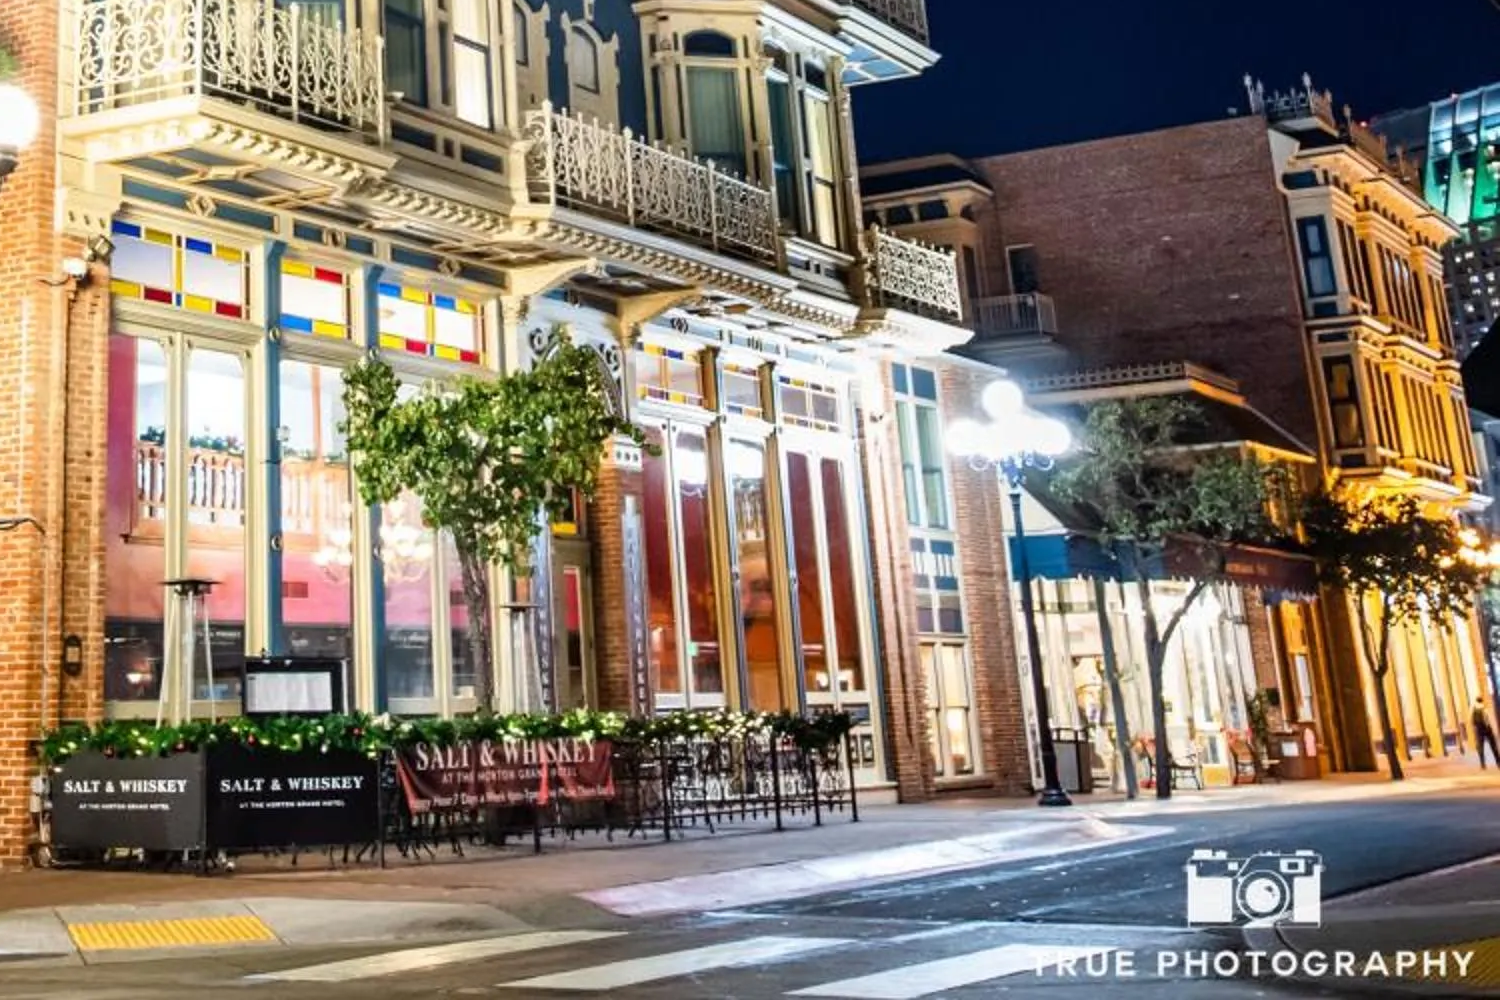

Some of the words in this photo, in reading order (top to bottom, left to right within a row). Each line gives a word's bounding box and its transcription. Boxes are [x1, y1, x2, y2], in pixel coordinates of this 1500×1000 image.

[416, 740, 470, 771] SALT
[479, 738, 496, 767] &
[63, 779, 101, 793] SALT
[105, 780, 115, 793] &
[120, 779, 187, 793] WHISKEY
[220, 777, 265, 793] SALT
[270, 777, 282, 791] &
[287, 775, 364, 791] WHISKEY
